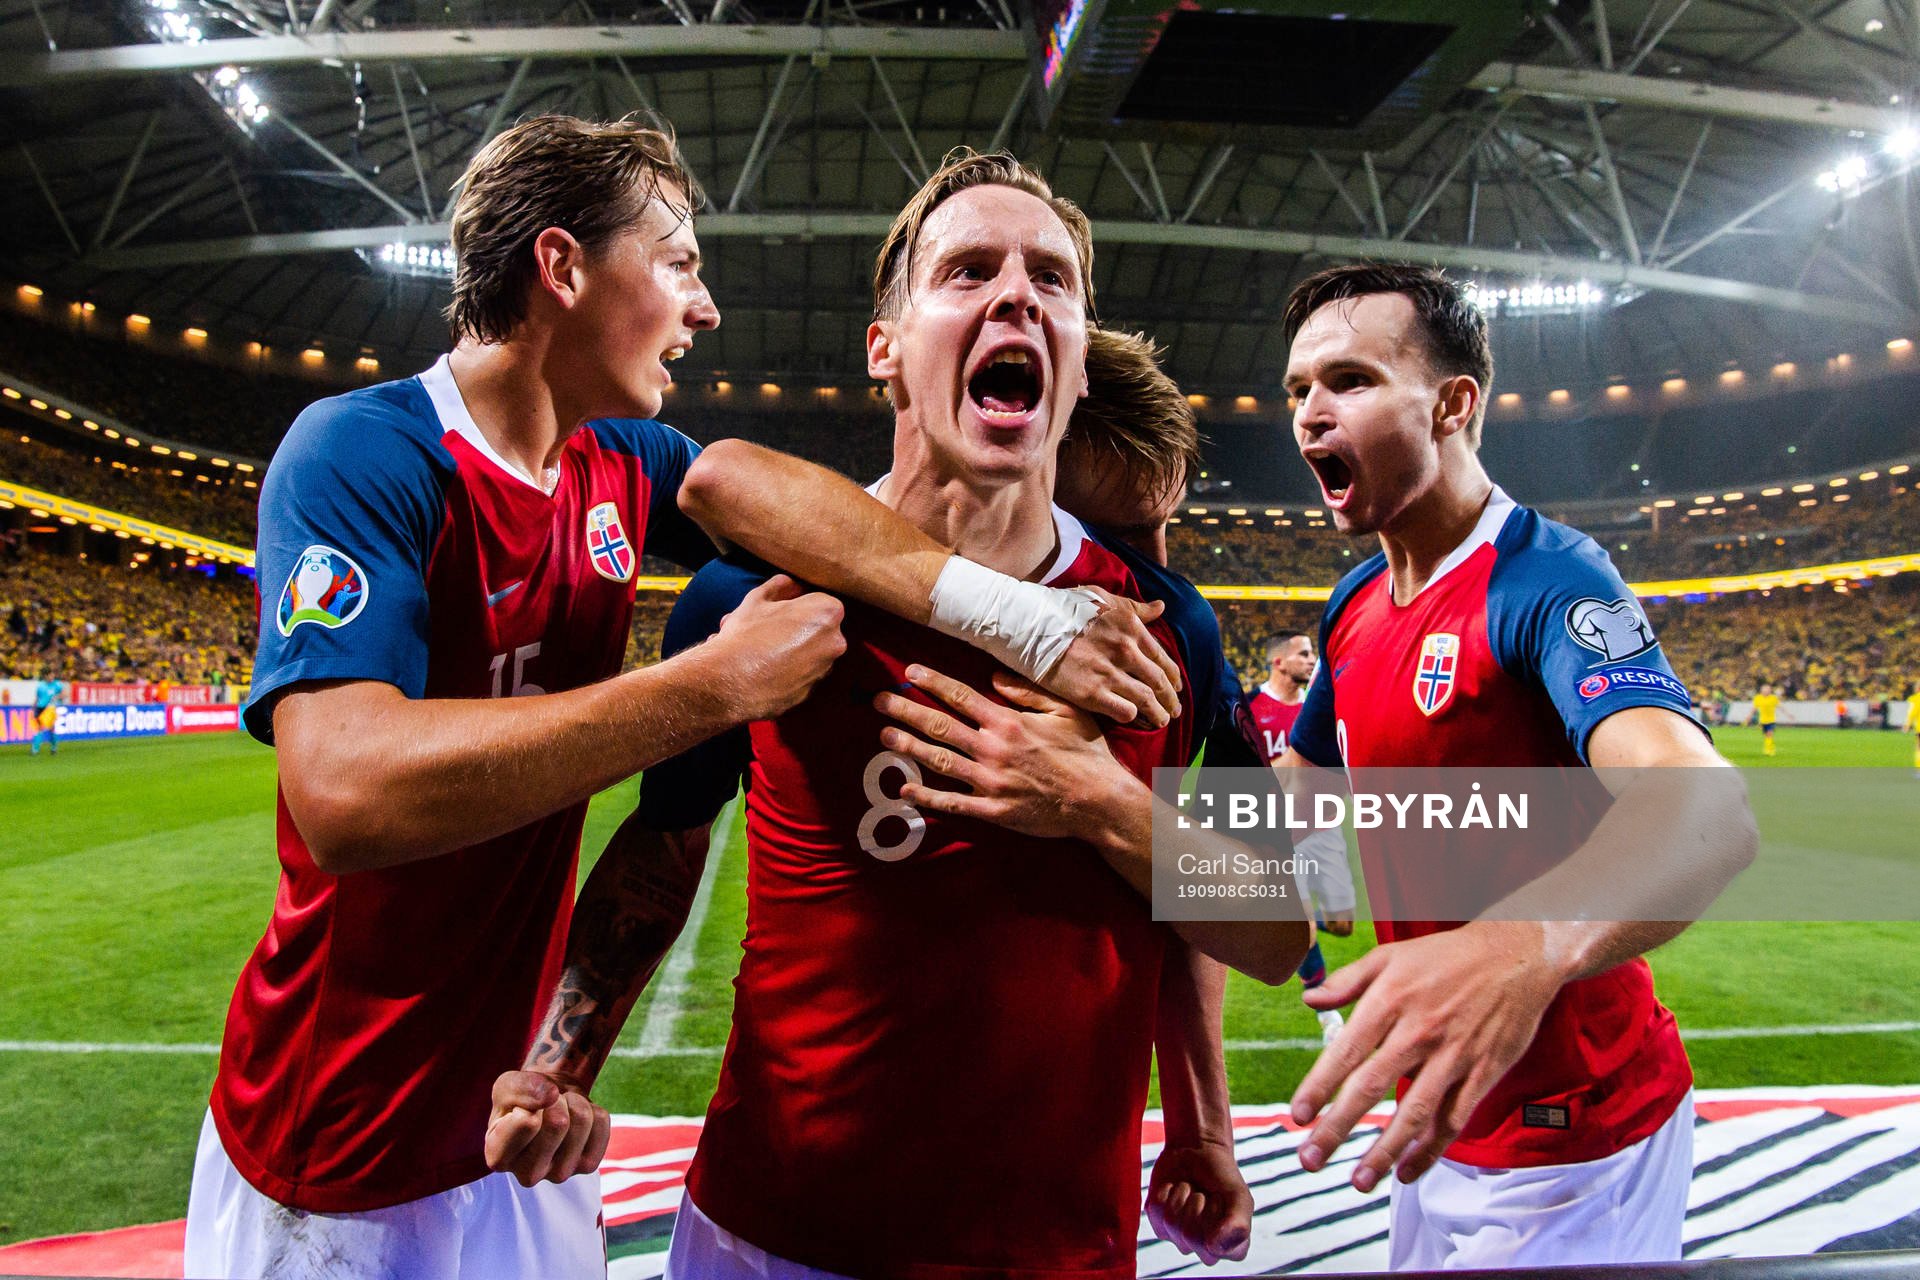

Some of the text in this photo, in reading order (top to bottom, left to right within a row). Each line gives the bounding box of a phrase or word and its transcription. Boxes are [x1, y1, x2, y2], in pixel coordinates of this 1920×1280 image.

[489, 641, 546, 698] 15
[54, 706, 125, 735] Entrance
[126, 706, 165, 731] Doors
[1263, 729, 1289, 758] 14
[857, 750, 927, 862] 8
